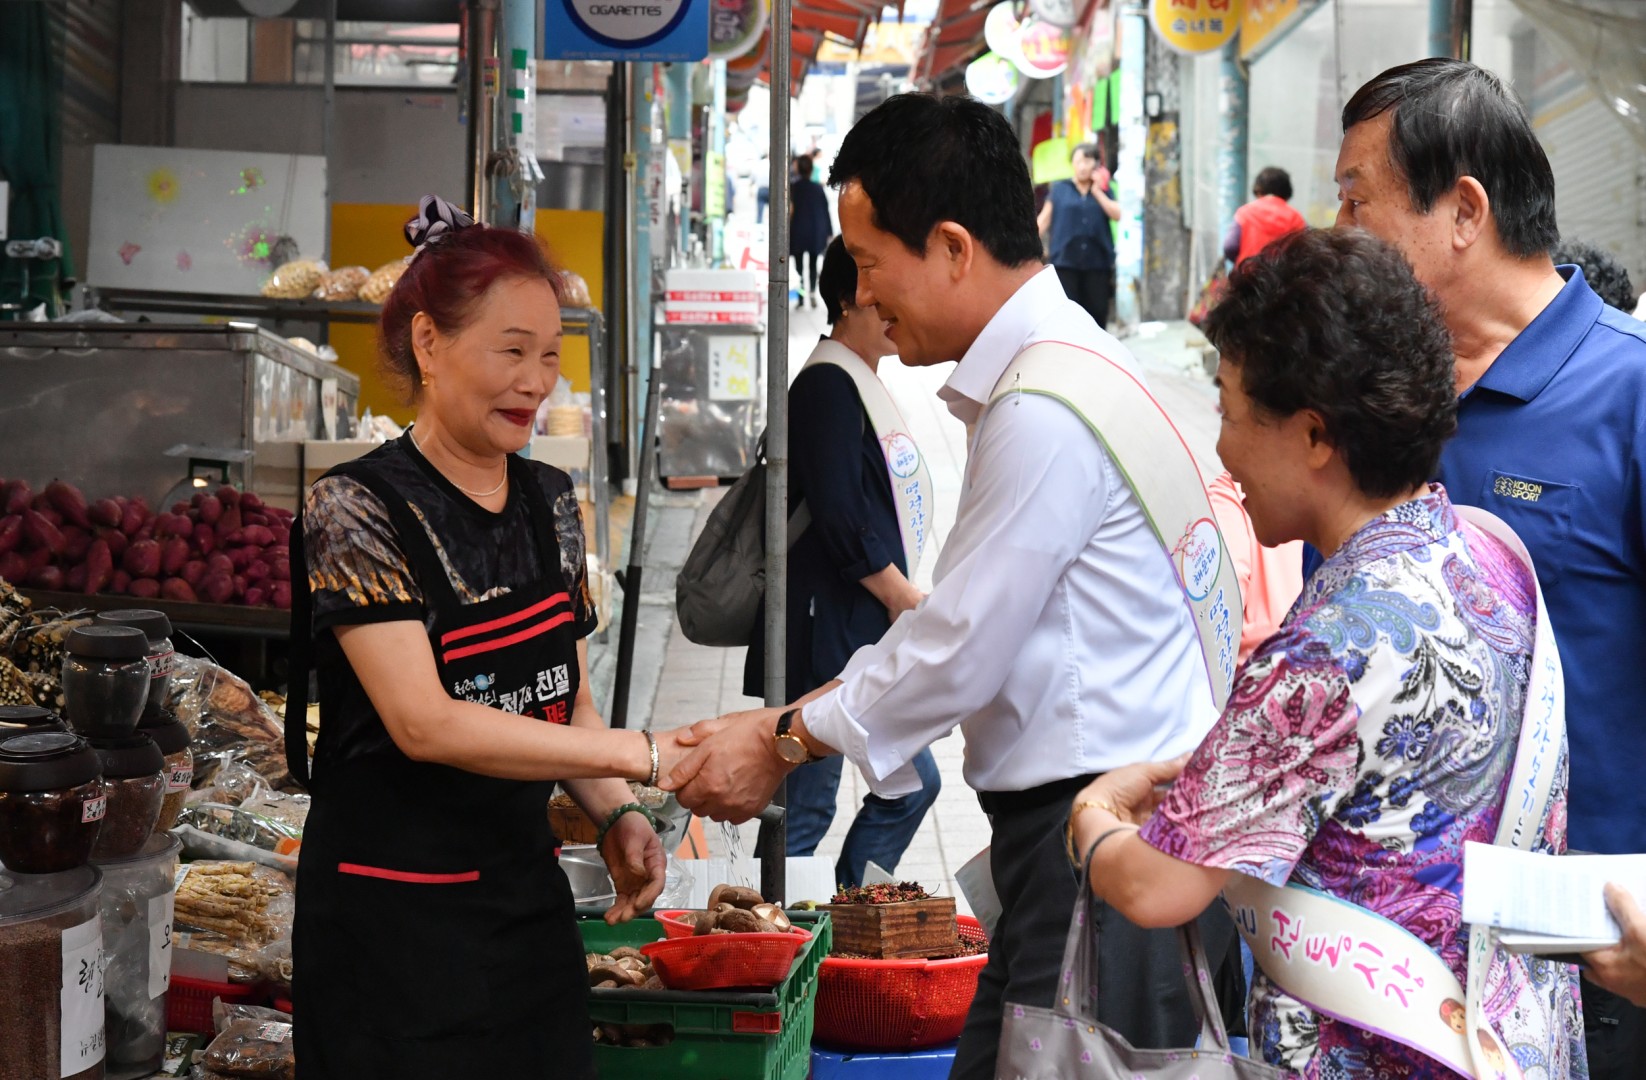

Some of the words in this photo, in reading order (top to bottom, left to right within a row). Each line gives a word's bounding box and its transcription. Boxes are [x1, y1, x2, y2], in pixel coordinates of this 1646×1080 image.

[589, 5, 662, 17] CIGARETTES
[1511, 488, 1540, 502] SPORT
[1513, 480, 1542, 494] KOLON
[1193, 547, 1217, 586] 해운대
[535, 663, 570, 702] 친절
[1271, 909, 1425, 1008] 전통시장
